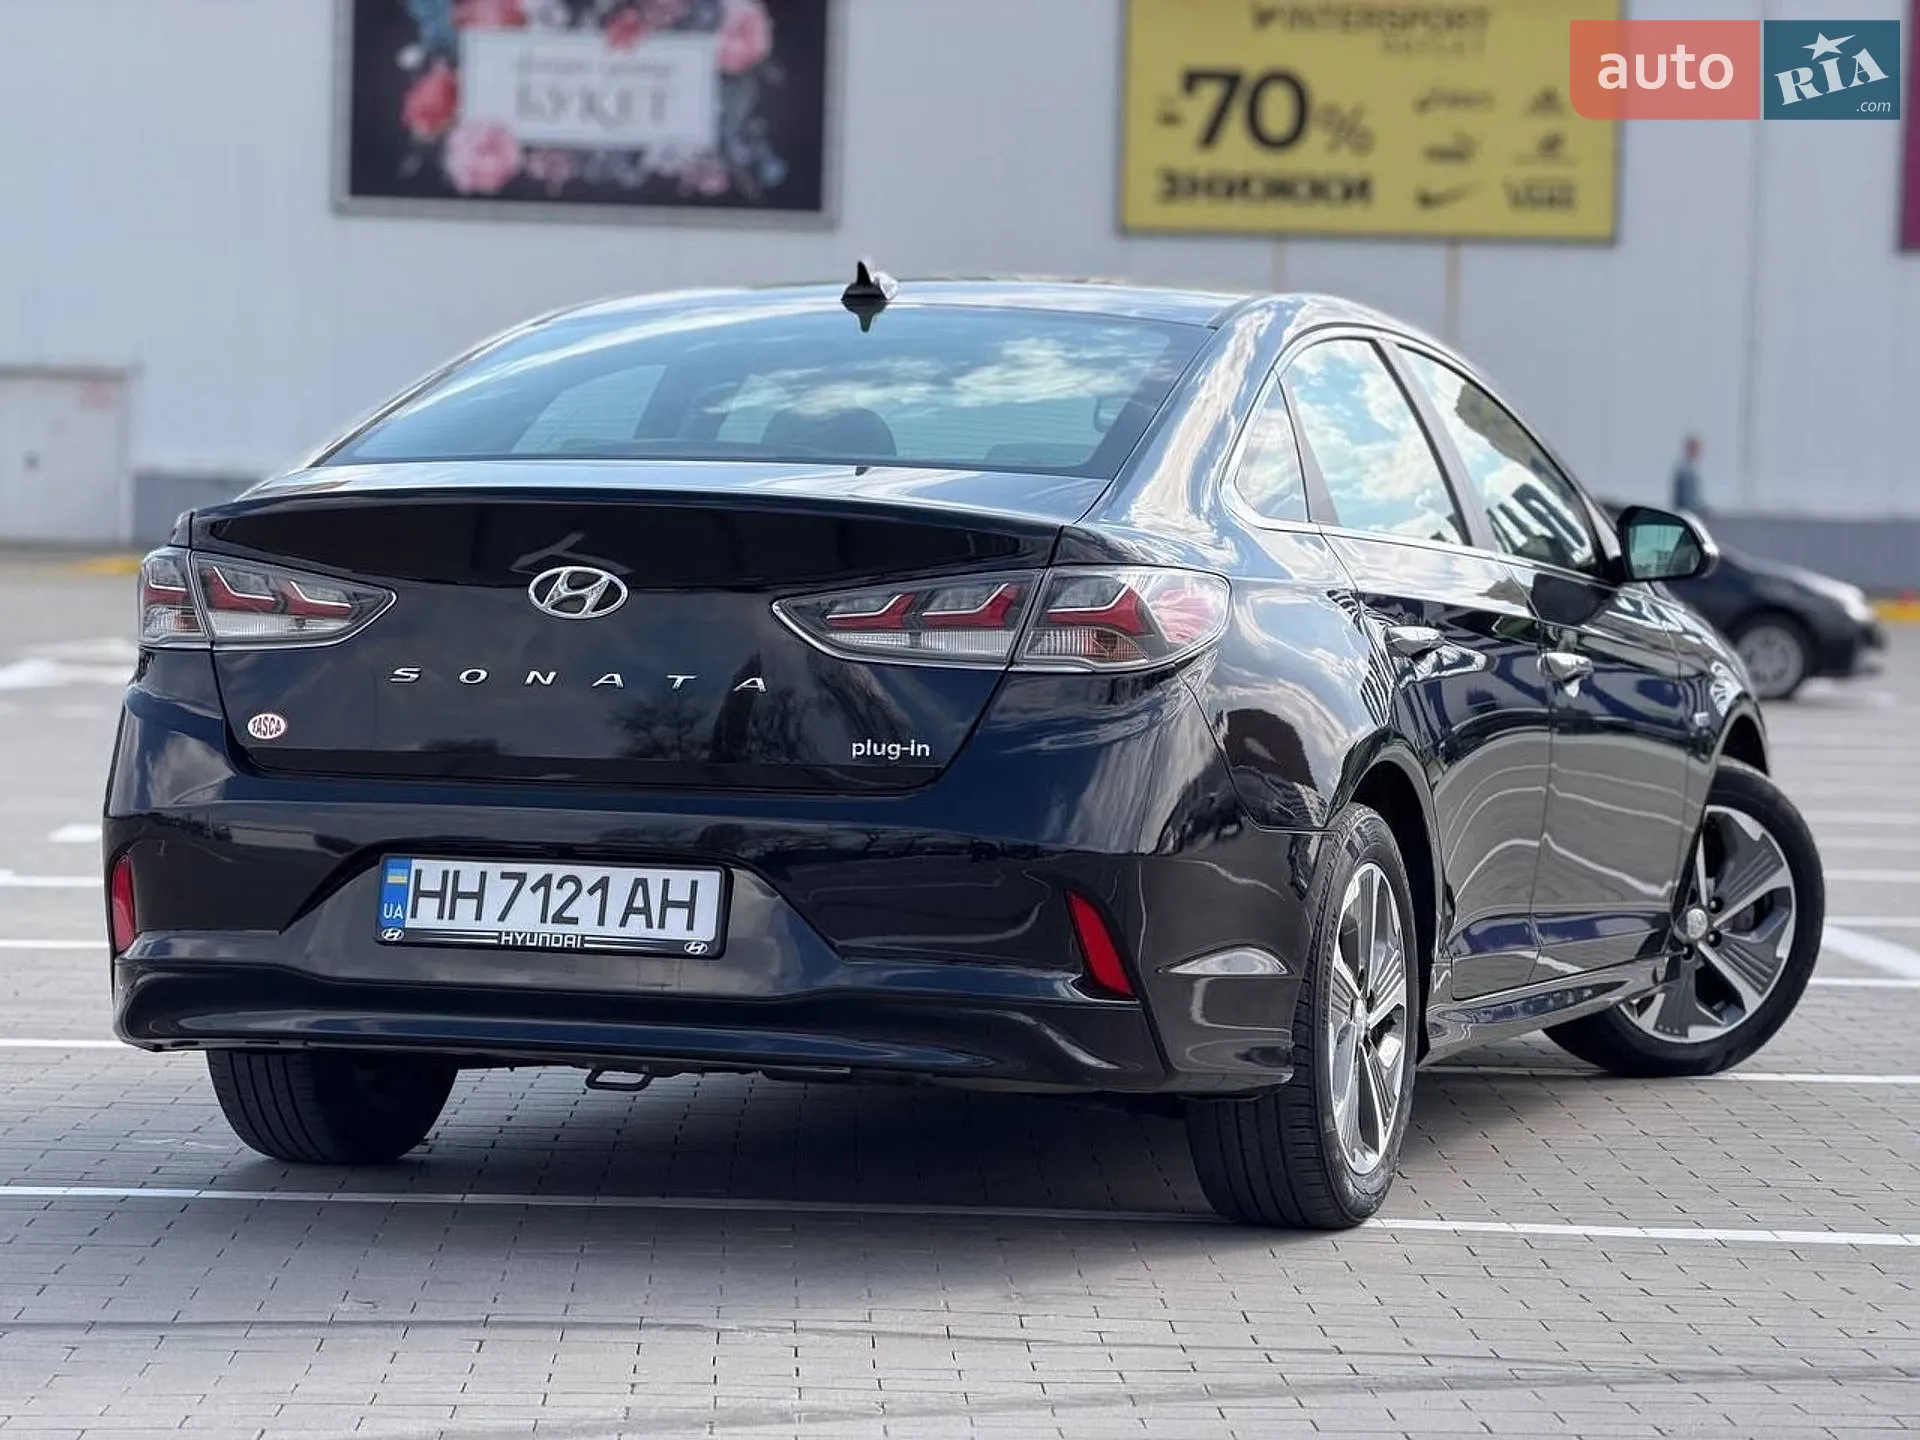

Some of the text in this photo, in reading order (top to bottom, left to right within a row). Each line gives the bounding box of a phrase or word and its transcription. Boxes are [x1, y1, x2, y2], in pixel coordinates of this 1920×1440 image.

[390, 667, 770, 694] SONATA
[851, 739, 930, 760] plug-in
[383, 903, 405, 920] UA
[501, 931, 585, 949] HYUNDAI
